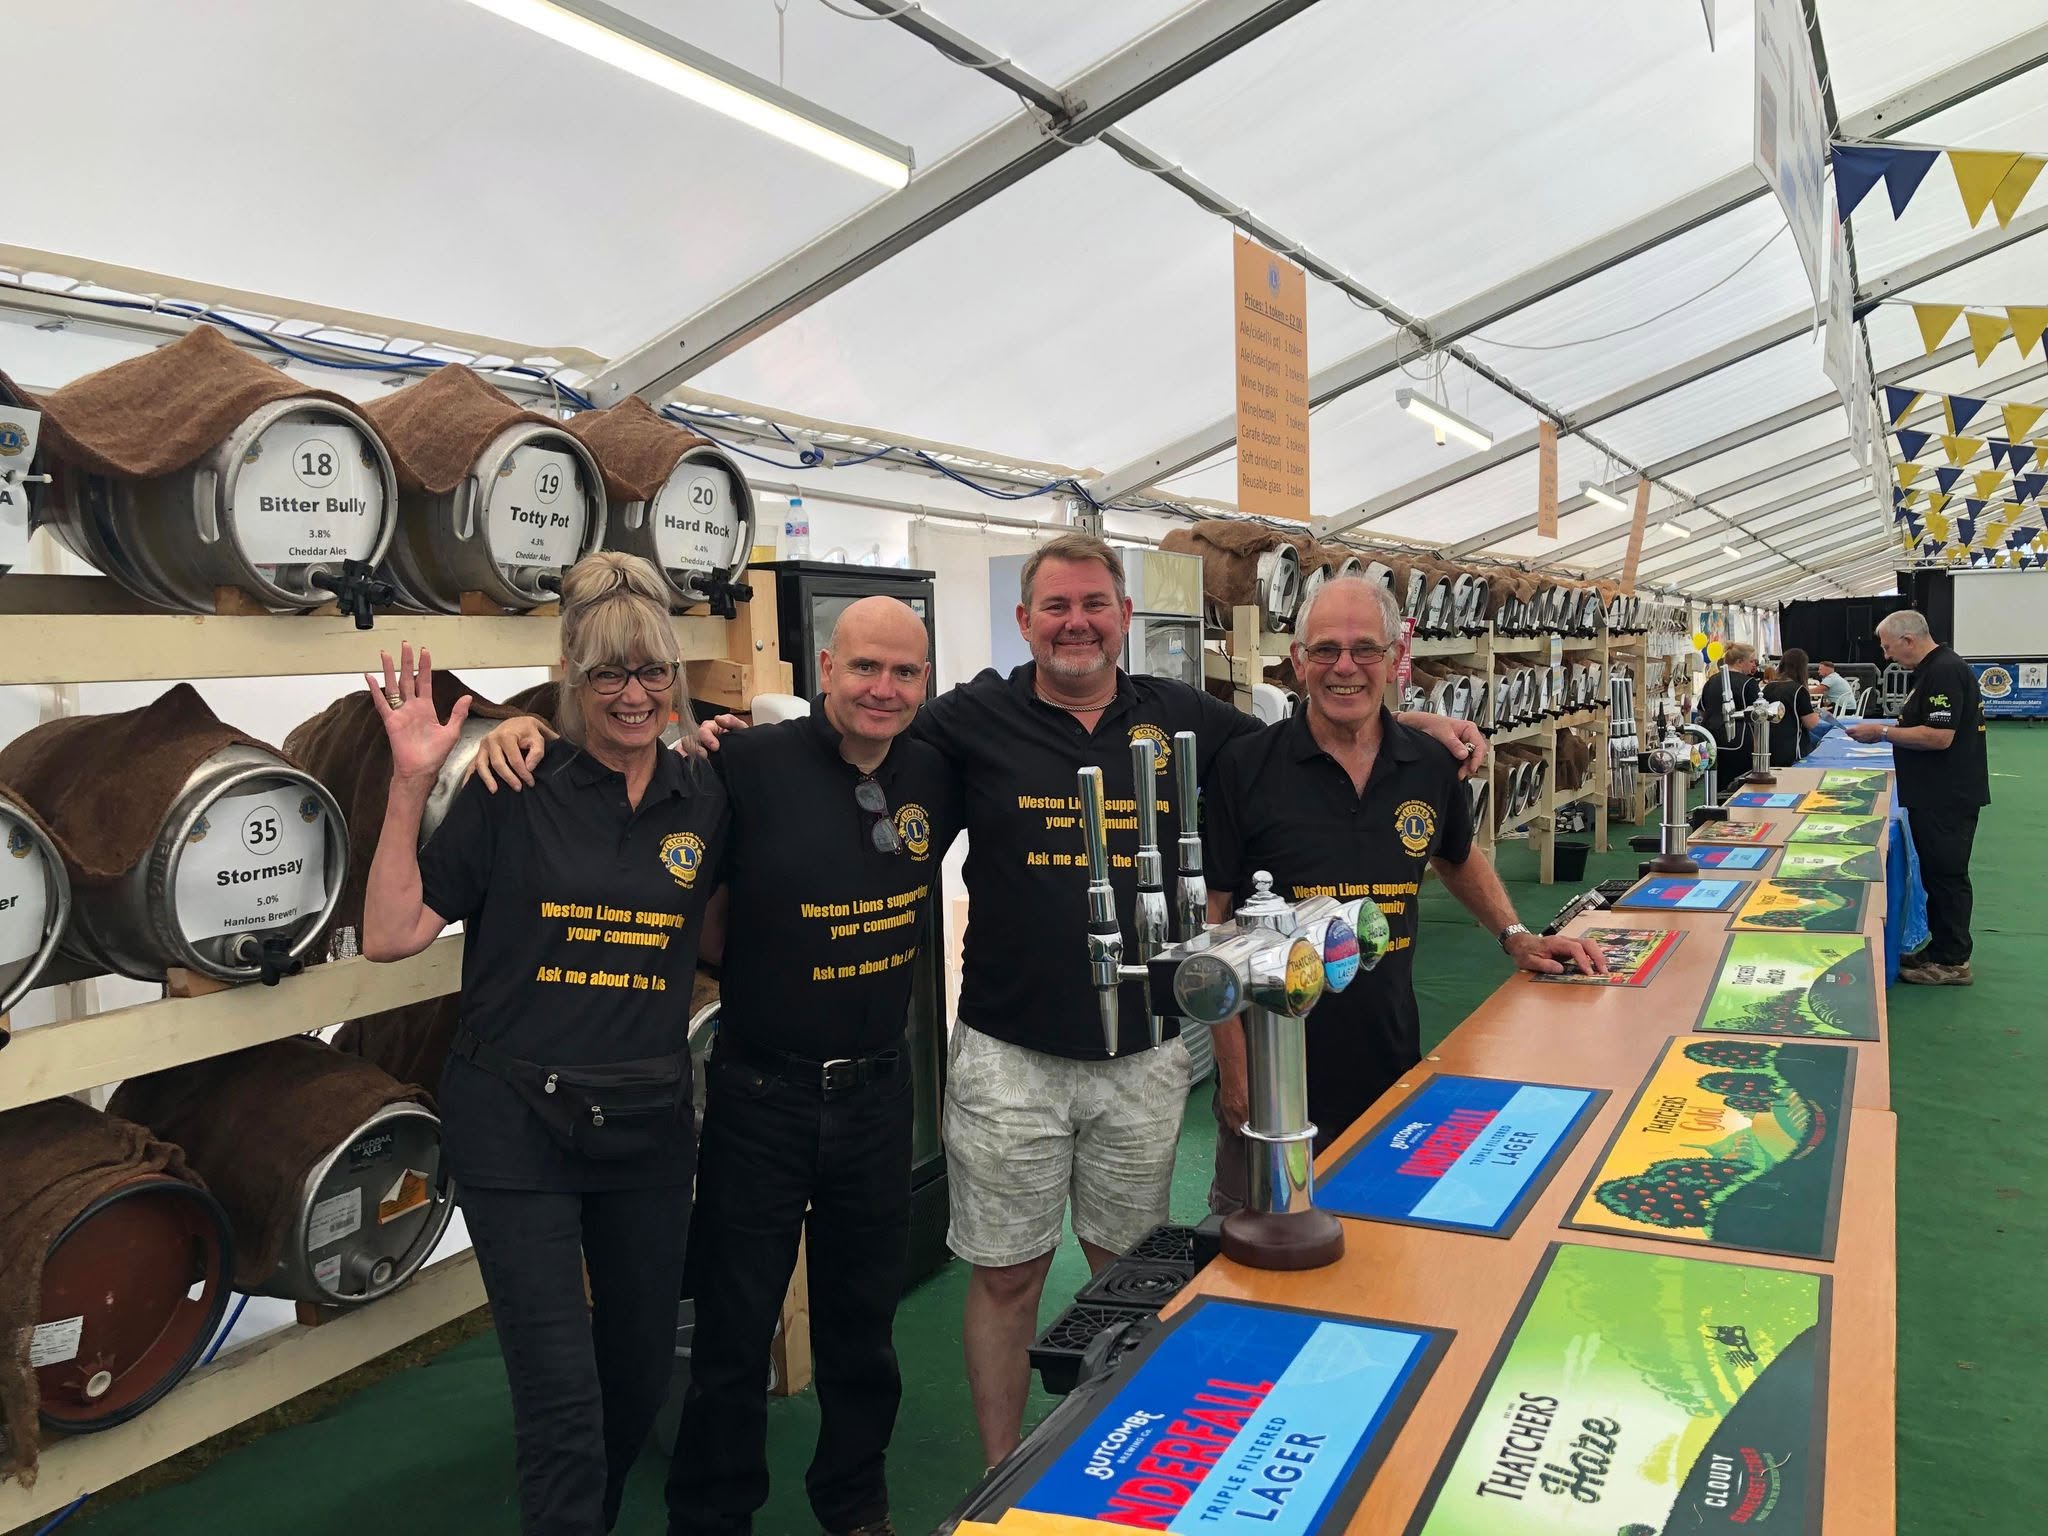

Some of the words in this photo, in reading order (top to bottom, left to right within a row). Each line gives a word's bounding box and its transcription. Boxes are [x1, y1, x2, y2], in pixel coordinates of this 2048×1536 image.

[1245, 292, 1264, 311] Prices:
[1270, 304, 1285, 321] token
[1290, 313, 1302, 331] £2.00
[1289, 341, 1302, 358] token
[1241, 373, 1257, 391] Wine
[1257, 377, 1264, 396] by
[1265, 383, 1278, 398] glass
[1241, 424, 1260, 442] Carafe
[1260, 429, 1281, 448] deposit
[301, 452, 333, 476] 18
[1241, 449, 1254, 465] Soft
[1290, 463, 1304, 477] token
[539, 474, 560, 495] 19
[692, 486, 713, 506] 20
[1242, 473, 1268, 491] Reusable
[1268, 479, 1282, 495] glass
[1290, 482, 1304, 498] token
[259, 496, 321, 513] Bitter
[325, 497, 367, 516] Bully
[510, 506, 548, 529] Totty
[550, 513, 570, 529] Pot
[309, 529, 331, 539] 3.8%
[664, 514, 700, 533] Hard
[704, 521, 730, 539] Rock
[288, 547, 328, 556] Cheddar
[329, 546, 348, 556] Ales
[515, 551, 539, 561] Cheddar
[539, 552, 551, 562] Ales
[680, 556, 706, 566] Cheddar
[1018, 795, 1065, 810] Weston
[1403, 805, 1429, 819] LIONS
[902, 809, 923, 821] LIONS
[1045, 816, 1075, 830] your
[1410, 818, 1421, 836] L
[249, 818, 278, 845] 35
[910, 822, 922, 839] L
[666, 837, 698, 849] LIONS
[677, 848, 693, 866] L
[1027, 851, 1050, 866] Ask
[1053, 854, 1072, 866] me
[1112, 853, 1132, 867] the
[216, 858, 304, 887] Stormsay
[256, 895, 280, 907] 5.0%
[1293, 885, 1337, 899] Weston
[1339, 882, 1370, 897] Lions
[1372, 881, 1419, 897] supporting
[223, 911, 267, 928] Hanlons
[268, 906, 298, 923] Brewery
[541, 902, 593, 919] Weston
[596, 905, 632, 923] Lions
[801, 903, 850, 918] Weston
[853, 899, 884, 915] Lions
[830, 923, 860, 940] your
[863, 909, 917, 933] community
[566, 926, 601, 942] your
[604, 930, 670, 949] community
[536, 966, 563, 983] Ask
[565, 969, 587, 985] me
[590, 970, 630, 988] about
[633, 973, 649, 990] the
[812, 966, 835, 981] Ask
[838, 965, 856, 978] me
[859, 957, 889, 975] about
[890, 952, 905, 968] the
[1642, 1095, 1688, 1134] THATCHERS
[1678, 1105, 1727, 1133] Gold
[1390, 1121, 1433, 1150] BUTCOMBE
[1396, 1108, 1498, 1178] UNDERFALL
[1469, 1145, 1490, 1166] TRIPLE
[1486, 1124, 1512, 1151] FILTERED
[1490, 1131, 1539, 1166] LAGER
[1084, 1410, 1166, 1481] BUTCOMBE
[1096, 1378, 1275, 1532] NDERFALL
[1116, 1437, 1145, 1464] BREWING
[1476, 1391, 1559, 1501] THATCHERS
[1199, 1474, 1248, 1523] TRIPLE
[1241, 1415, 1288, 1474] FILTERED
[1539, 1416, 1622, 1504] Haze
[1236, 1431, 1328, 1522] LAGER
[1704, 1453, 1734, 1508] CLOUDY
[1729, 1475, 1767, 1524] SOMERSET
